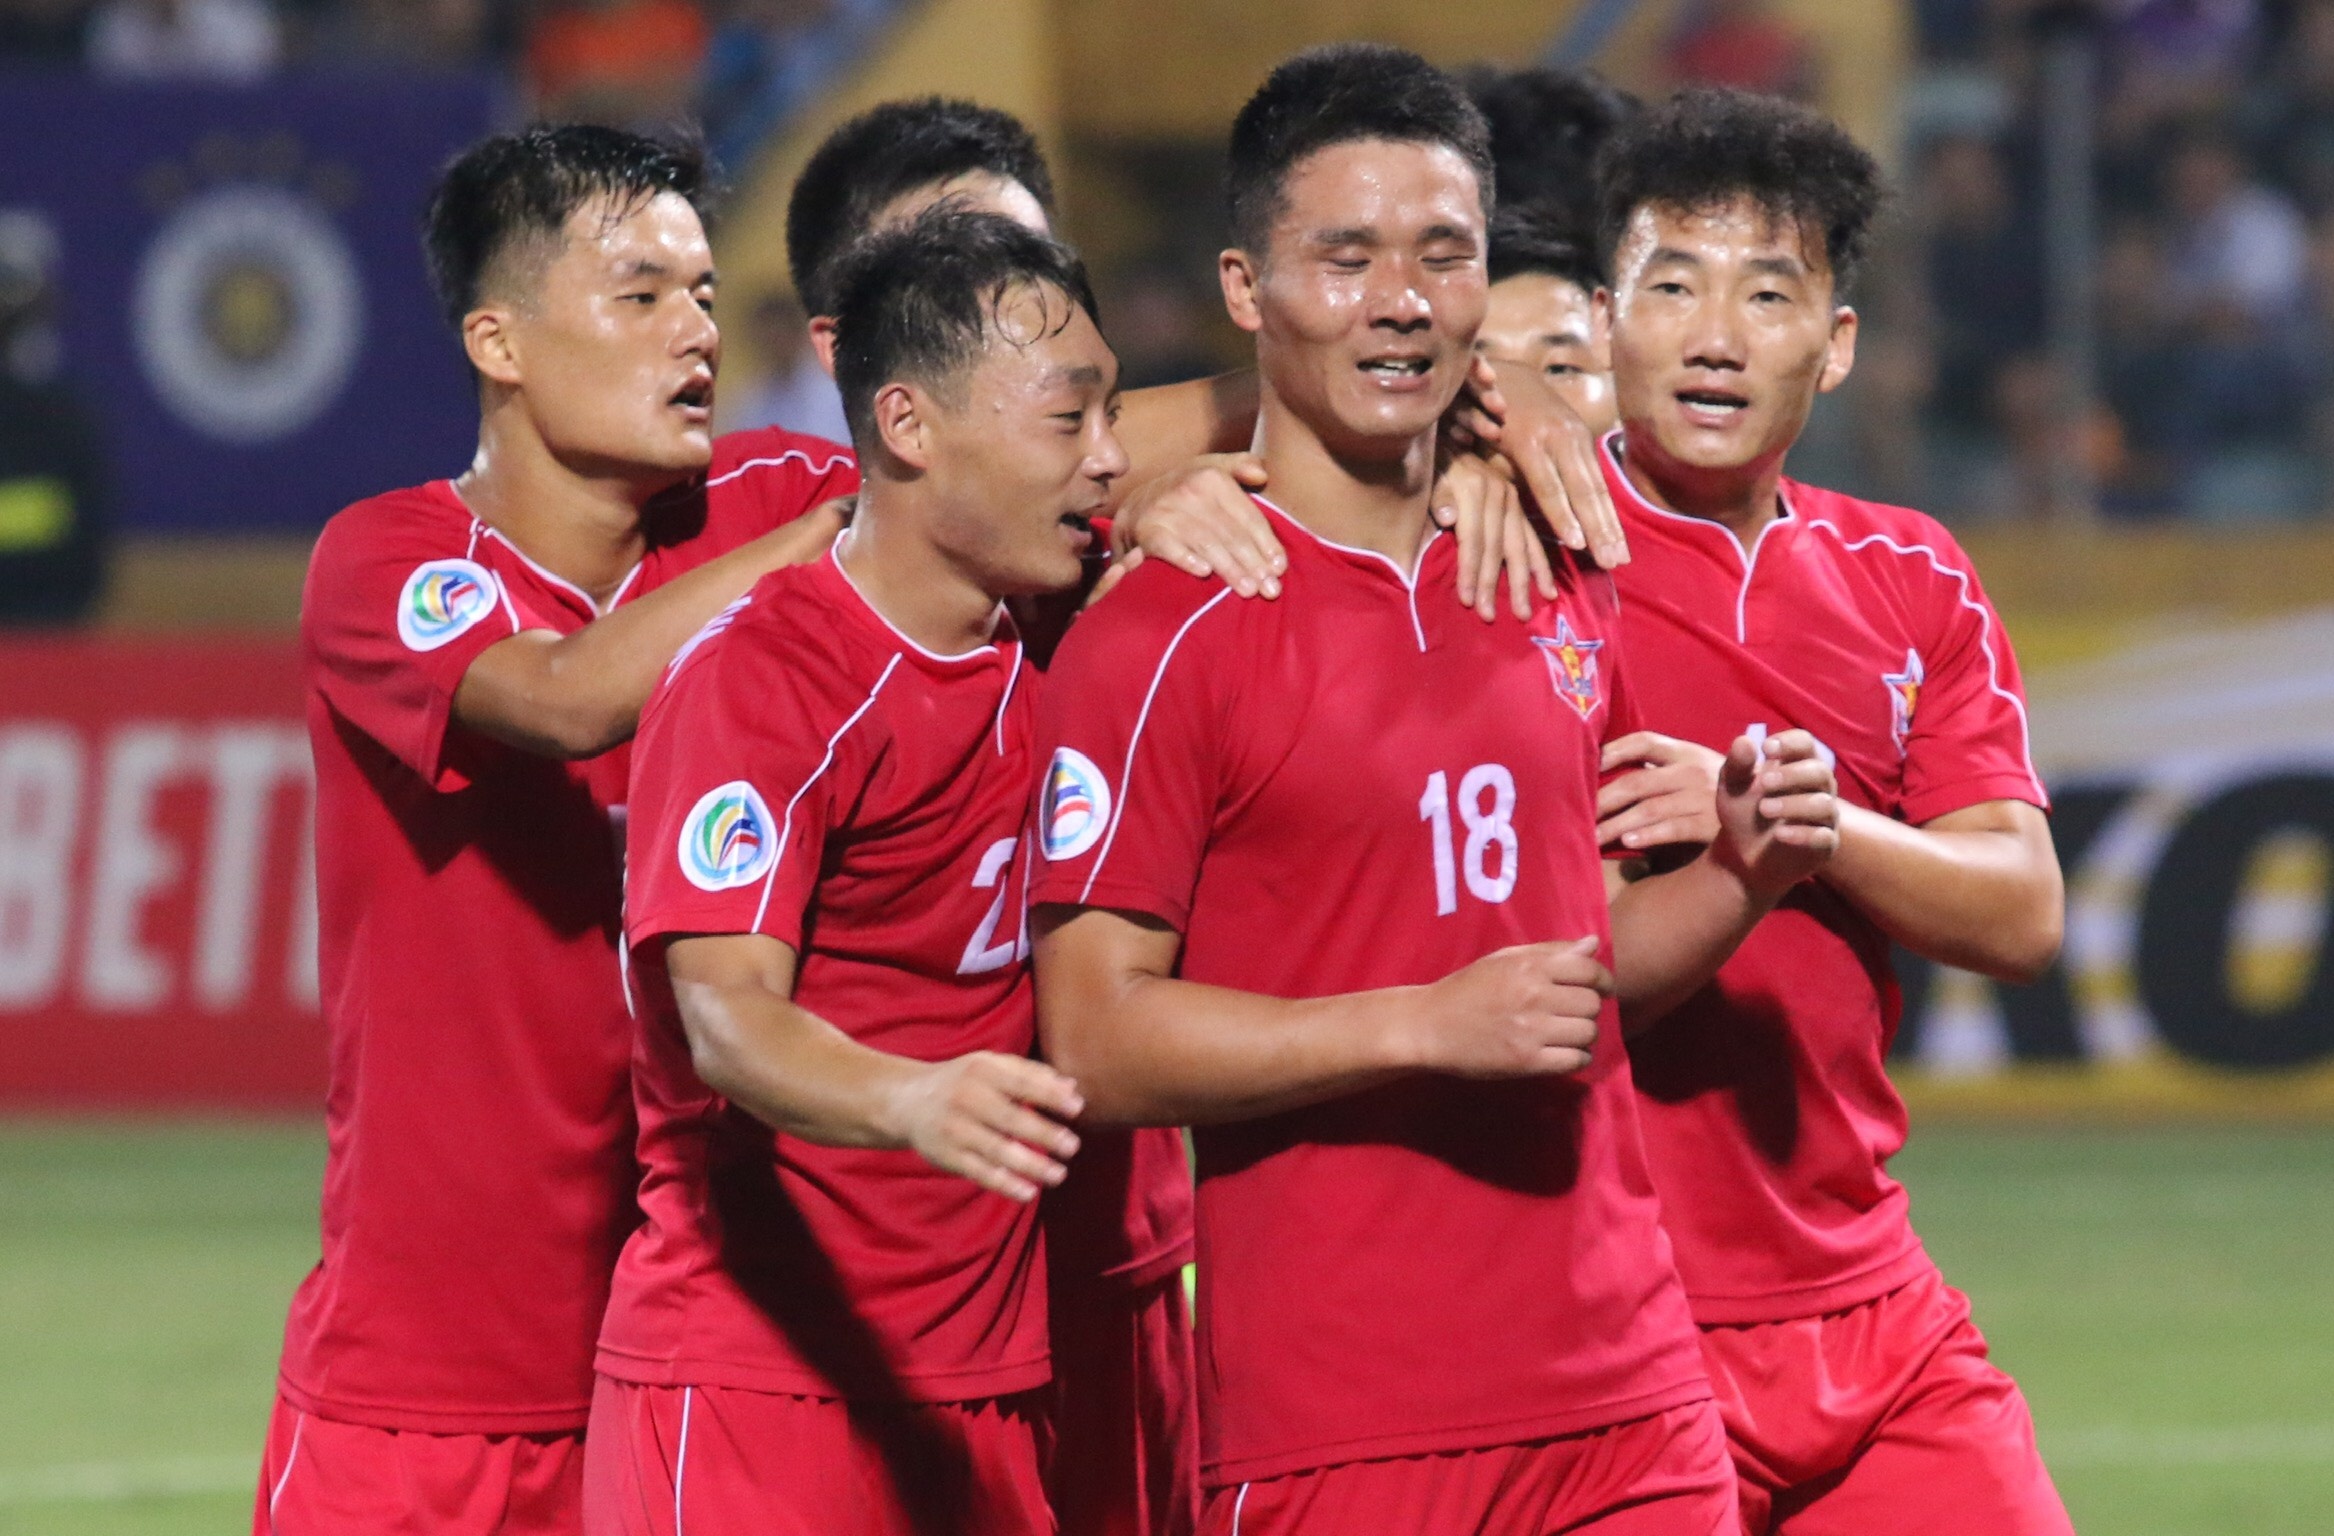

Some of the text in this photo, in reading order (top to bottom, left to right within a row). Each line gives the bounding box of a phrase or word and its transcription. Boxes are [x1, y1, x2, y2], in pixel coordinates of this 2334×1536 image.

[0, 722, 320, 1011] BET
[956, 827, 1030, 975] 2
[1419, 763, 1517, 916] 18
